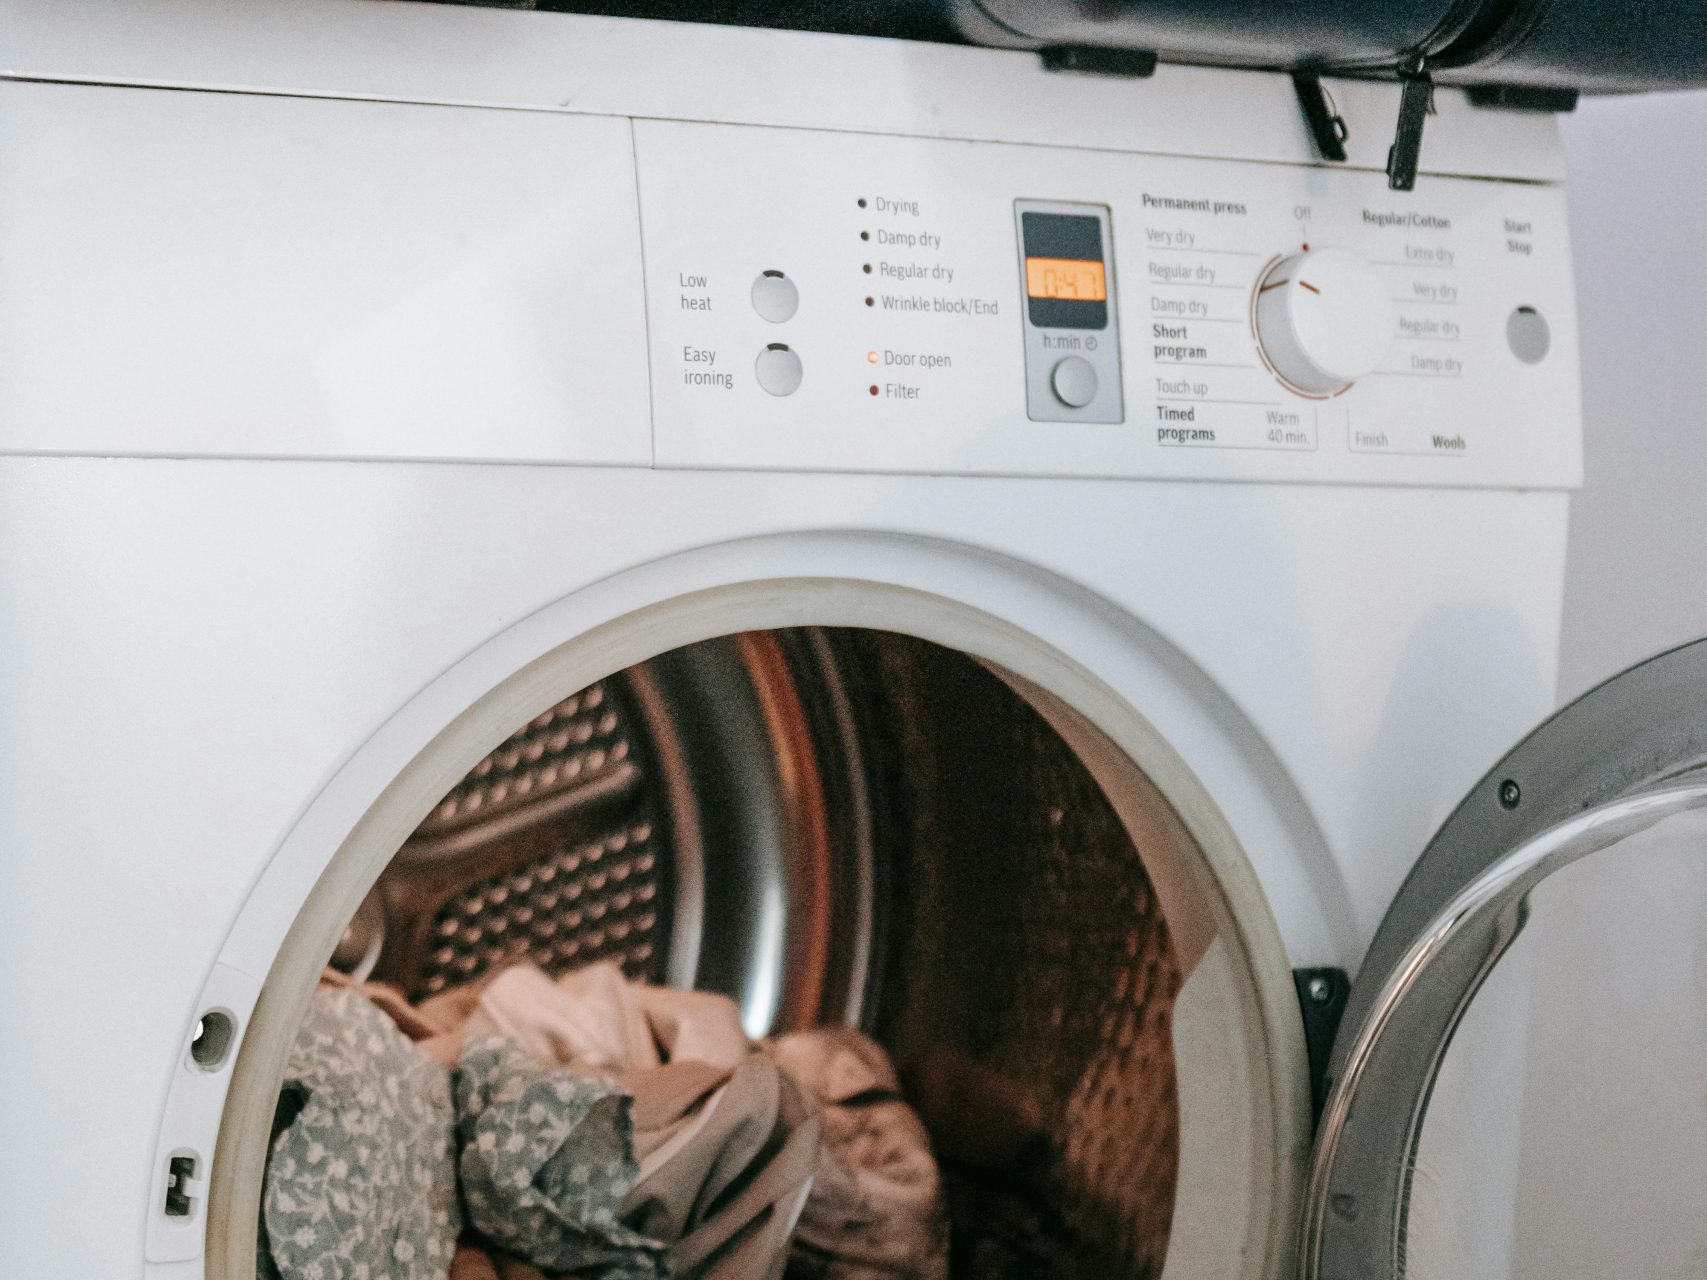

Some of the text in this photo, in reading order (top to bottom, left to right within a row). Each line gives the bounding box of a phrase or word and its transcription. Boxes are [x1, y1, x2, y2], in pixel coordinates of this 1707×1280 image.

[876, 197, 919, 216] Drying
[1142, 193, 1247, 215] Permanent press
[1294, 205, 1311, 221] Off
[1504, 218, 1532, 234] Start
[878, 229, 941, 249] Damp dry
[1146, 227, 1195, 246] Very dry
[1405, 245, 1455, 264] Extra dry
[1507, 239, 1533, 256] Stop
[680, 272, 708, 288] Low
[880, 262, 954, 282] Regular dry
[1148, 262, 1216, 282] Regular dry
[1412, 282, 1458, 300] Very dry
[681, 294, 712, 311] heat
[881, 296, 999, 315] Wrinkle block/End
[1151, 297, 1208, 316] Damp dry
[1153, 324, 1188, 340] Short
[1399, 318, 1461, 335] Regular dry
[1043, 334, 1081, 350] h:min
[684, 346, 716, 366] Easy
[885, 350, 952, 369] Door open
[1154, 344, 1207, 359] program
[1411, 355, 1463, 373] Damp dry
[684, 368, 733, 388] ironing
[886, 383, 920, 399] Filter
[1156, 378, 1208, 396] Touch up
[1157, 405, 1195, 422] Timed
[1266, 410, 1299, 426] Warm
[1157, 427, 1216, 442] programs
[1267, 429, 1311, 445] 40 min.
[1355, 432, 1389, 448] Finish
[1432, 435, 1467, 450] Wools
